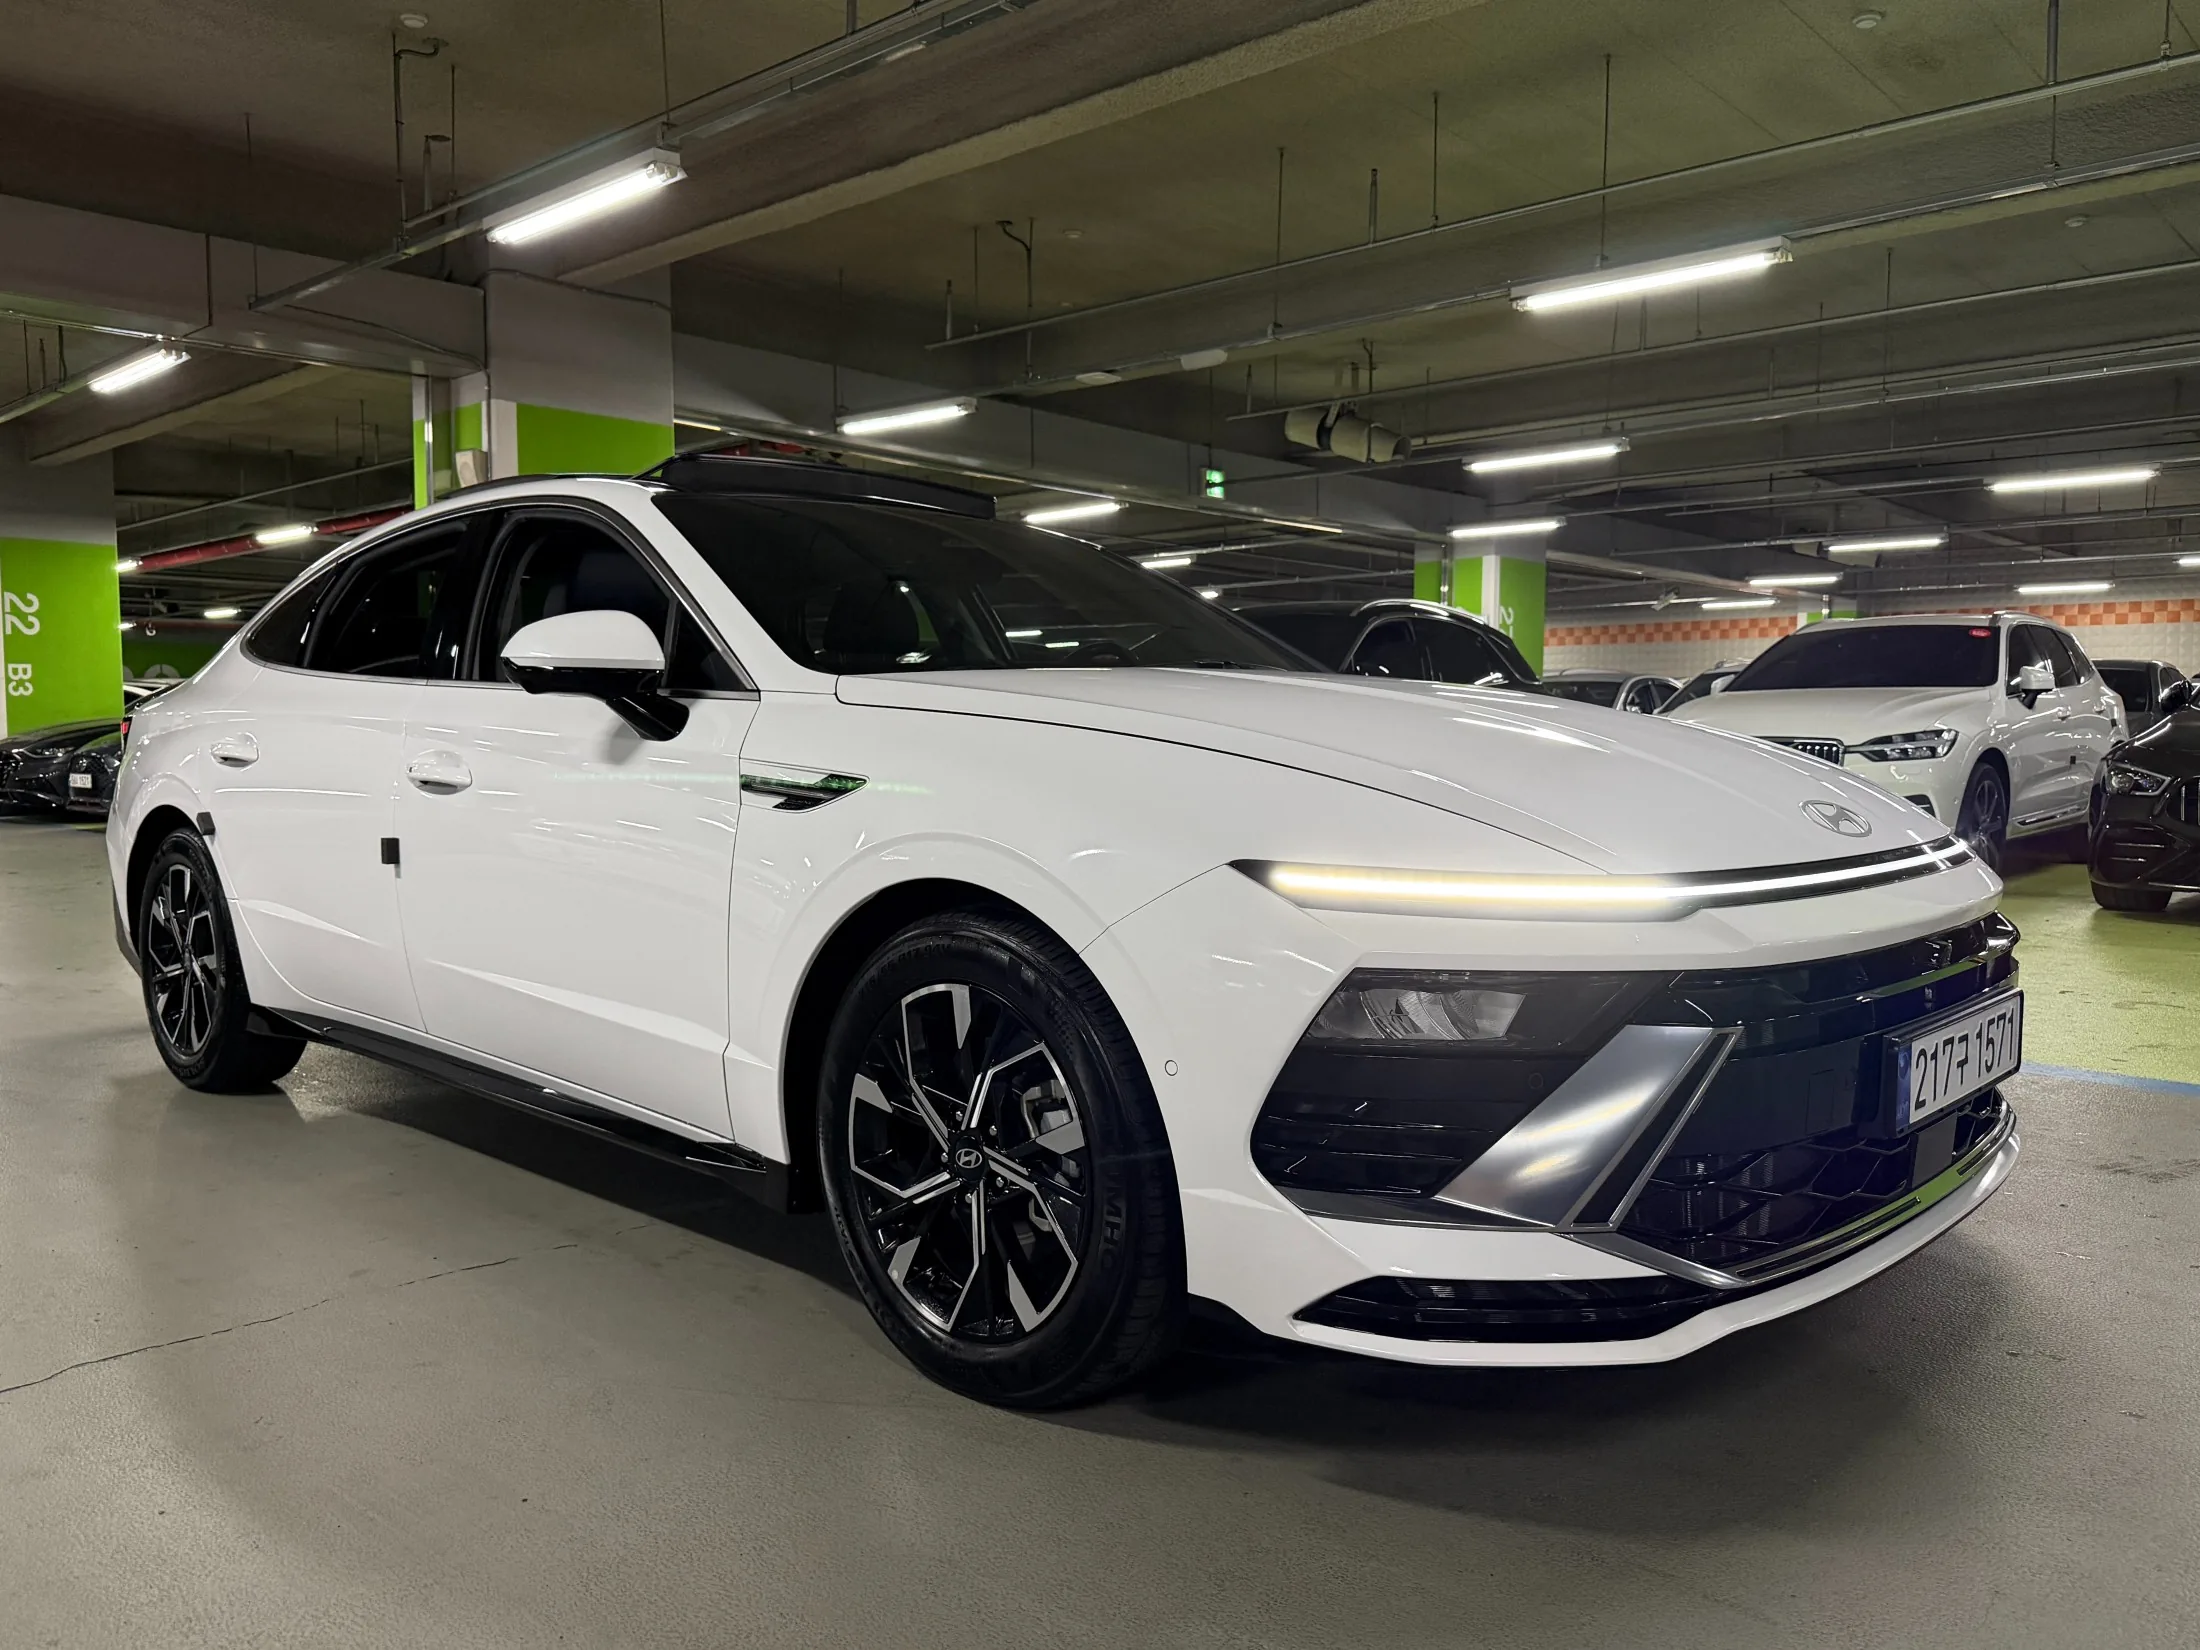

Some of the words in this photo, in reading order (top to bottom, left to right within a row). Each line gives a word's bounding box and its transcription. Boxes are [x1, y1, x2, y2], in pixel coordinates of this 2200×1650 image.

[4, 592, 40, 635] 22
[7, 663, 33, 696] B3
[1914, 1032, 1969, 1112] 217구
[1975, 1007, 2014, 1079] 1571
